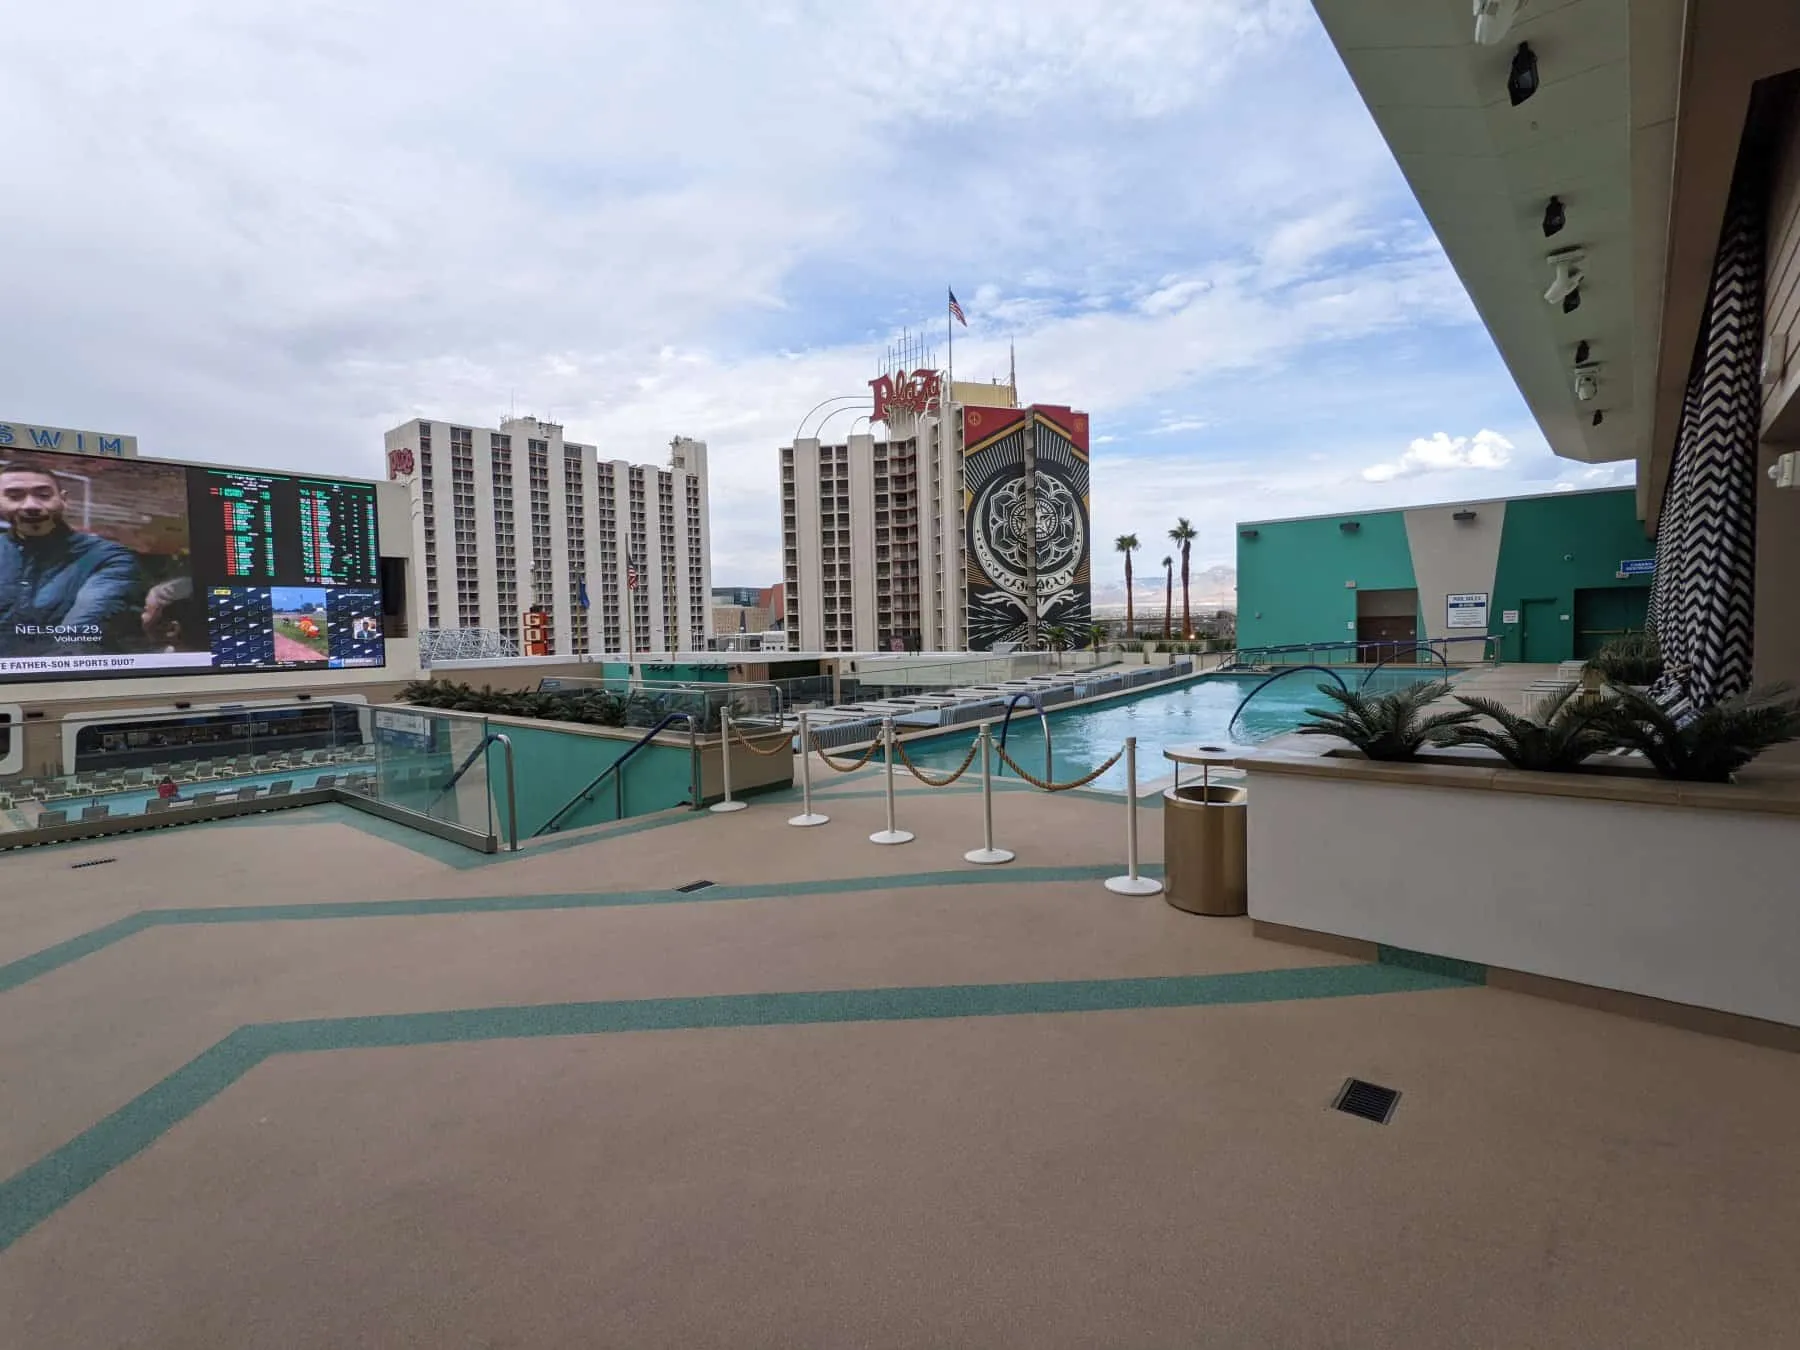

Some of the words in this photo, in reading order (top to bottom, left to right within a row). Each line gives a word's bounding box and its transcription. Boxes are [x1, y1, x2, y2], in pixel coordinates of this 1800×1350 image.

[0, 423, 124, 457] SWIM
[10, 660, 70, 670] FATHER-SON
[73, 658, 108, 667] SPORTS
[111, 658, 134, 666] DUO?
